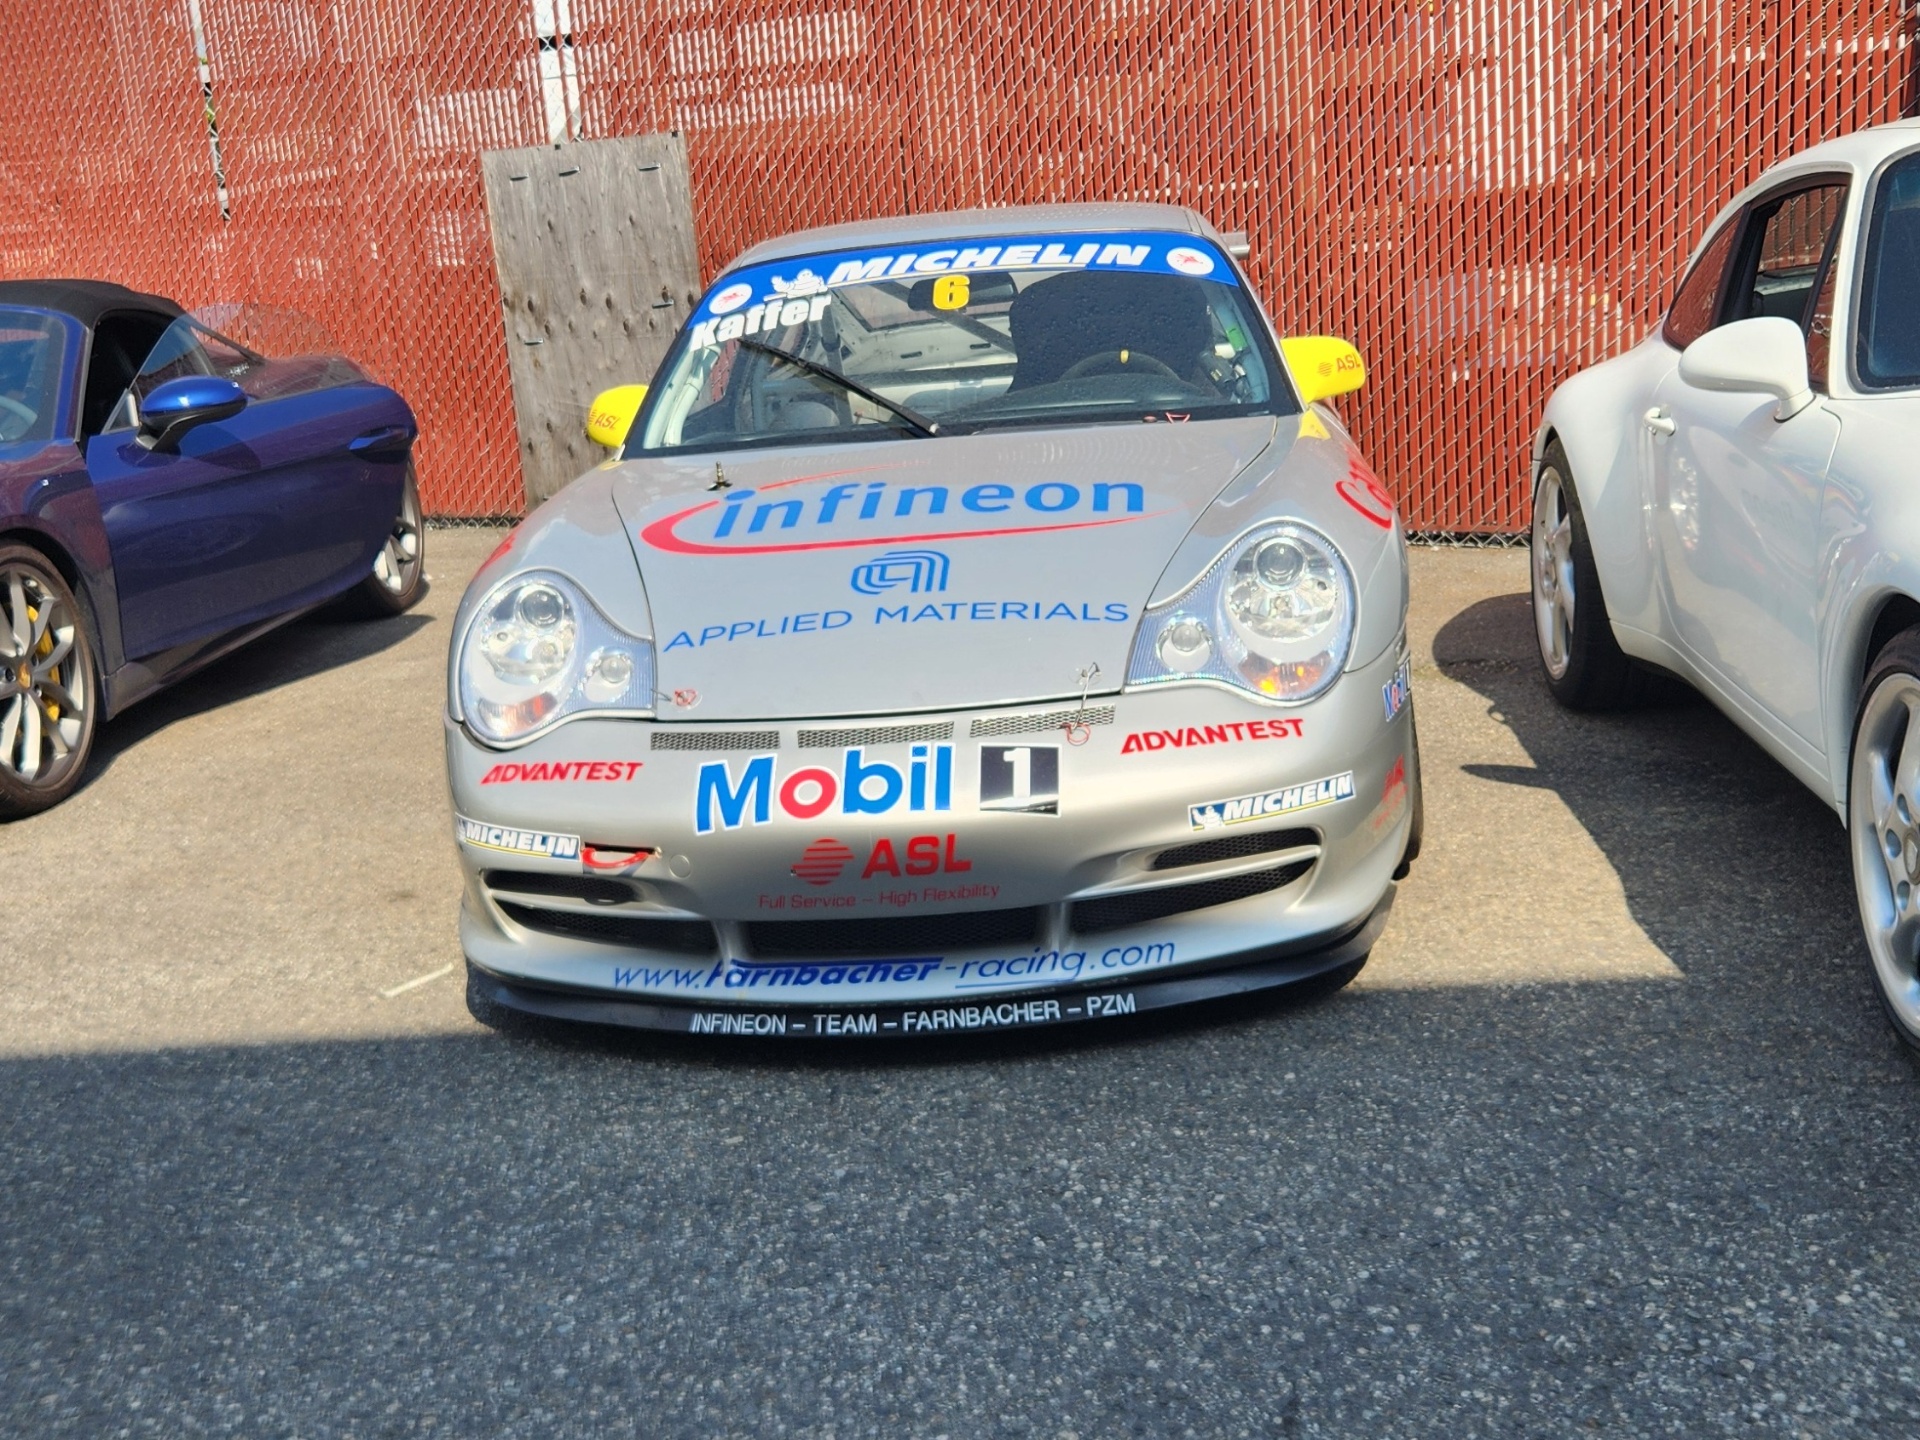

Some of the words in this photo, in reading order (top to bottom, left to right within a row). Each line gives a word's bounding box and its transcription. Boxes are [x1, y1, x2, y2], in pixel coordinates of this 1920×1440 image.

[828, 243, 1151, 284] MICHELIN
[932, 274, 970, 310] 6
[689, 294, 832, 352] Kaffer
[1336, 353, 1361, 373] ASL
[594, 412, 621, 431] ASL
[714, 481, 1145, 539] infineon
[663, 610, 853, 653] APPLIED
[875, 602, 1130, 624] MATERIALS
[1121, 718, 1305, 755] ADVANTEST
[480, 761, 643, 785] ADVANTEST
[696, 743, 955, 836] Mobil
[1222, 774, 1351, 821] MICHELIN
[465, 821, 578, 857] MICHELIN
[861, 833, 973, 880] ASL
[759, 894, 786, 909] Full
[791, 893, 857, 910] Service
[879, 890, 918, 908] High
[923, 884, 1001, 904] Flexibility
[689, 1012, 787, 1035] INFINEON
[813, 1013, 878, 1035] TEAM
[902, 999, 1061, 1032] FARNBACHER
[1086, 993, 1137, 1017] PZM
